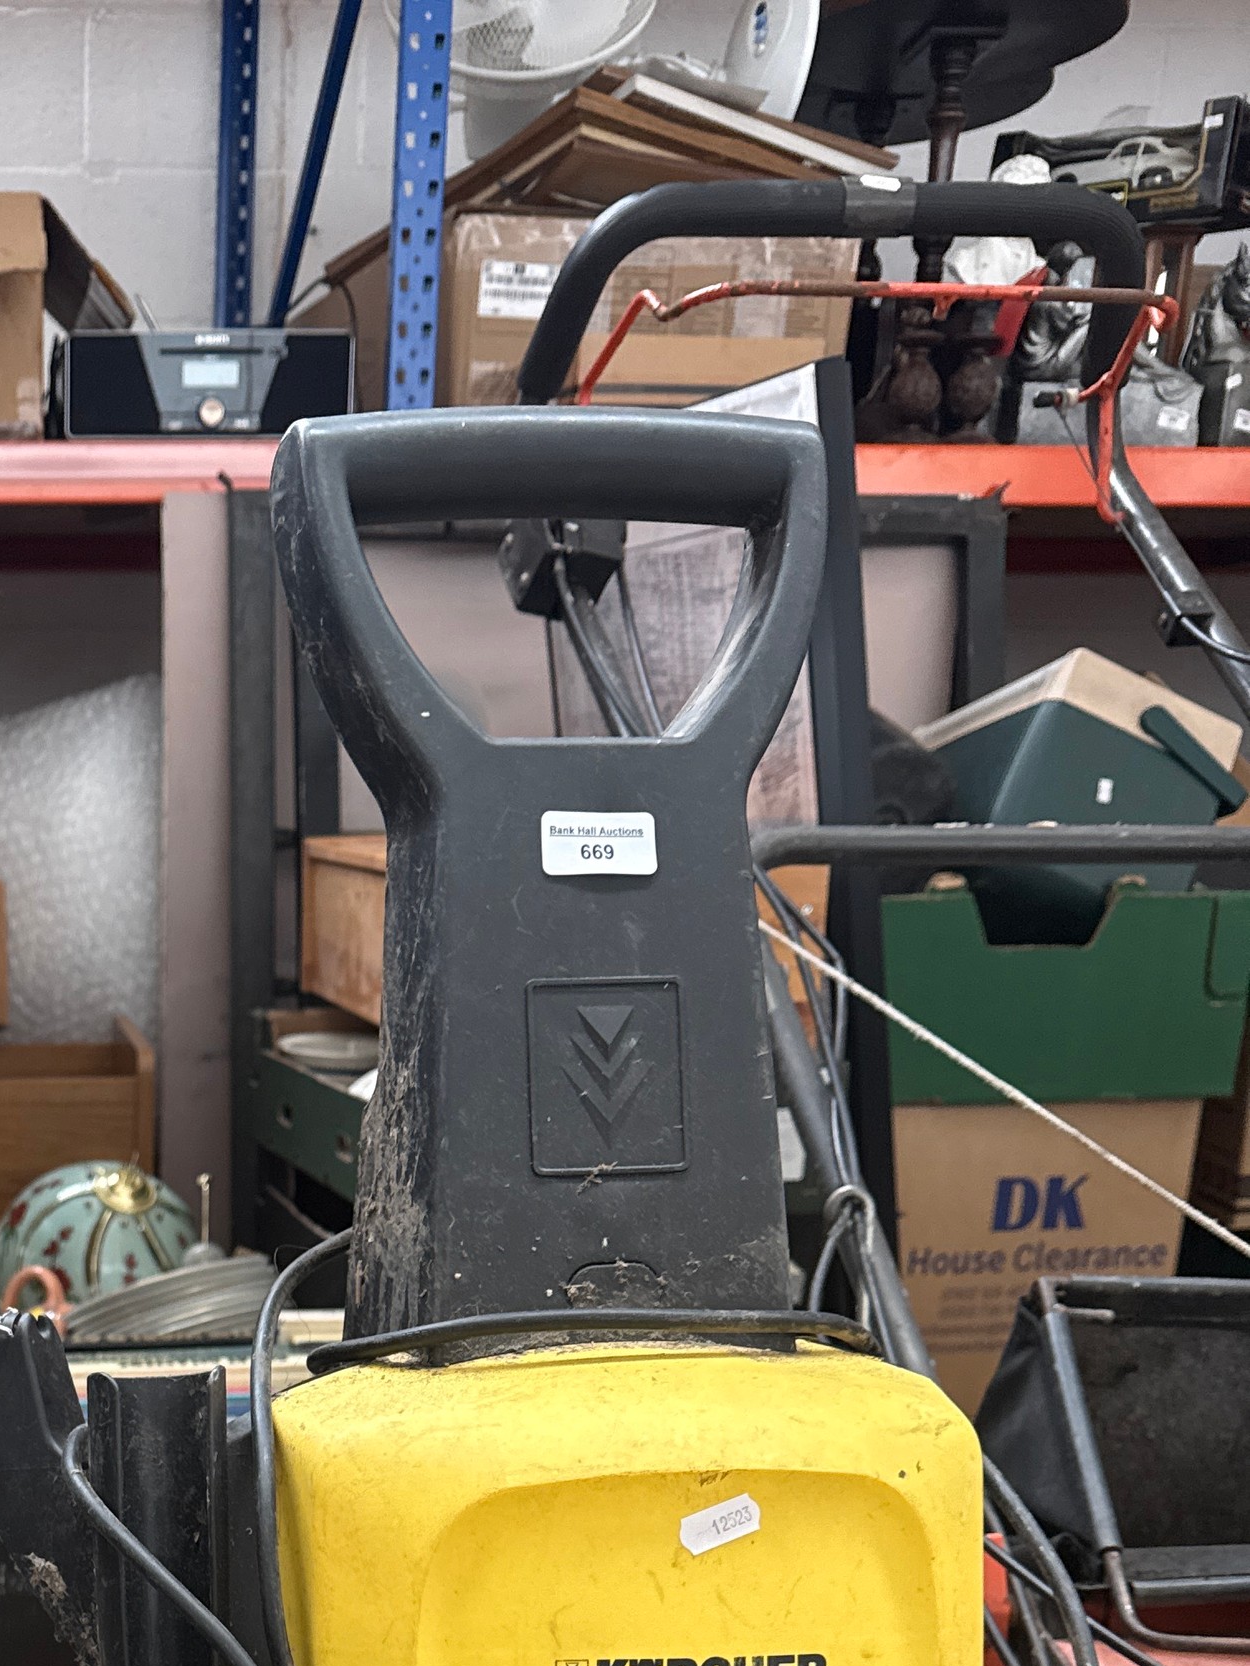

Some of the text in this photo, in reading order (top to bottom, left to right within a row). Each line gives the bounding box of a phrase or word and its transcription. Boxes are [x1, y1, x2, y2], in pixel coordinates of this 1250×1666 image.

[550, 826, 644, 837] Bank Hall Auctions
[580, 844, 615, 860] 669
[990, 1174, 1089, 1233] DK
[906, 1241, 1169, 1276] House Clearance
[710, 1505, 753, 1536] 12523
